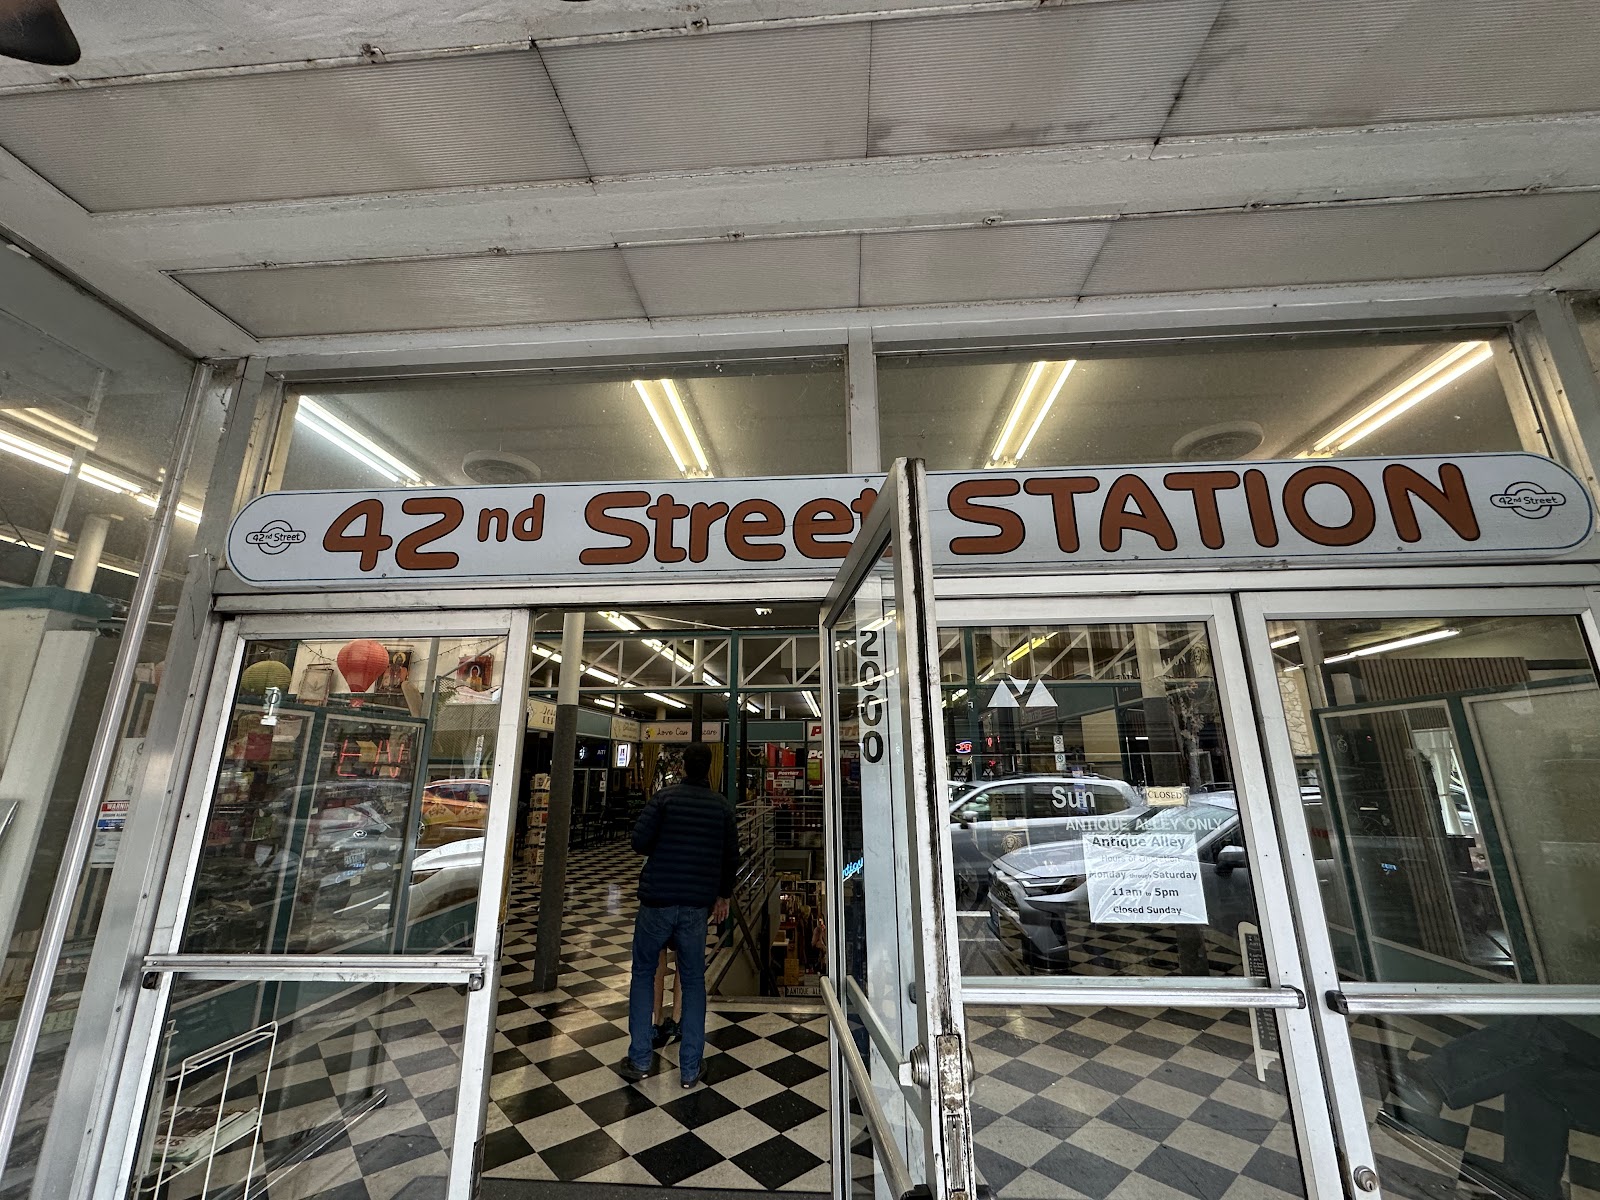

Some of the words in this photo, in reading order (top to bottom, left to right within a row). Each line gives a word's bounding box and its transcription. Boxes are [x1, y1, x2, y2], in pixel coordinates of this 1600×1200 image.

[1523, 495, 1558, 505] Street
[947, 462, 1481, 555] STATION
[252, 533, 272, 542] 42nd
[273, 532, 300, 542] Street
[859, 629, 884, 764] 2000
[1052, 786, 1095, 808] Sun
[1147, 791, 1183, 800] CLOSED
[107, 803, 129, 811] WARNIN
[1066, 819, 1130, 832] ANTIQUE
[1135, 818, 1179, 832] ALLEY
[1185, 818, 1222, 831] ONLY
[1092, 836, 1147, 849] Antique
[1151, 836, 1185, 849] Alley
[1152, 870, 1197, 880] Saturday
[1112, 887, 1142, 896] 11am
[1154, 887, 1179, 898] 5pm
[1113, 905, 1144, 914] Closed
[1146, 906, 1182, 916] Sunday
